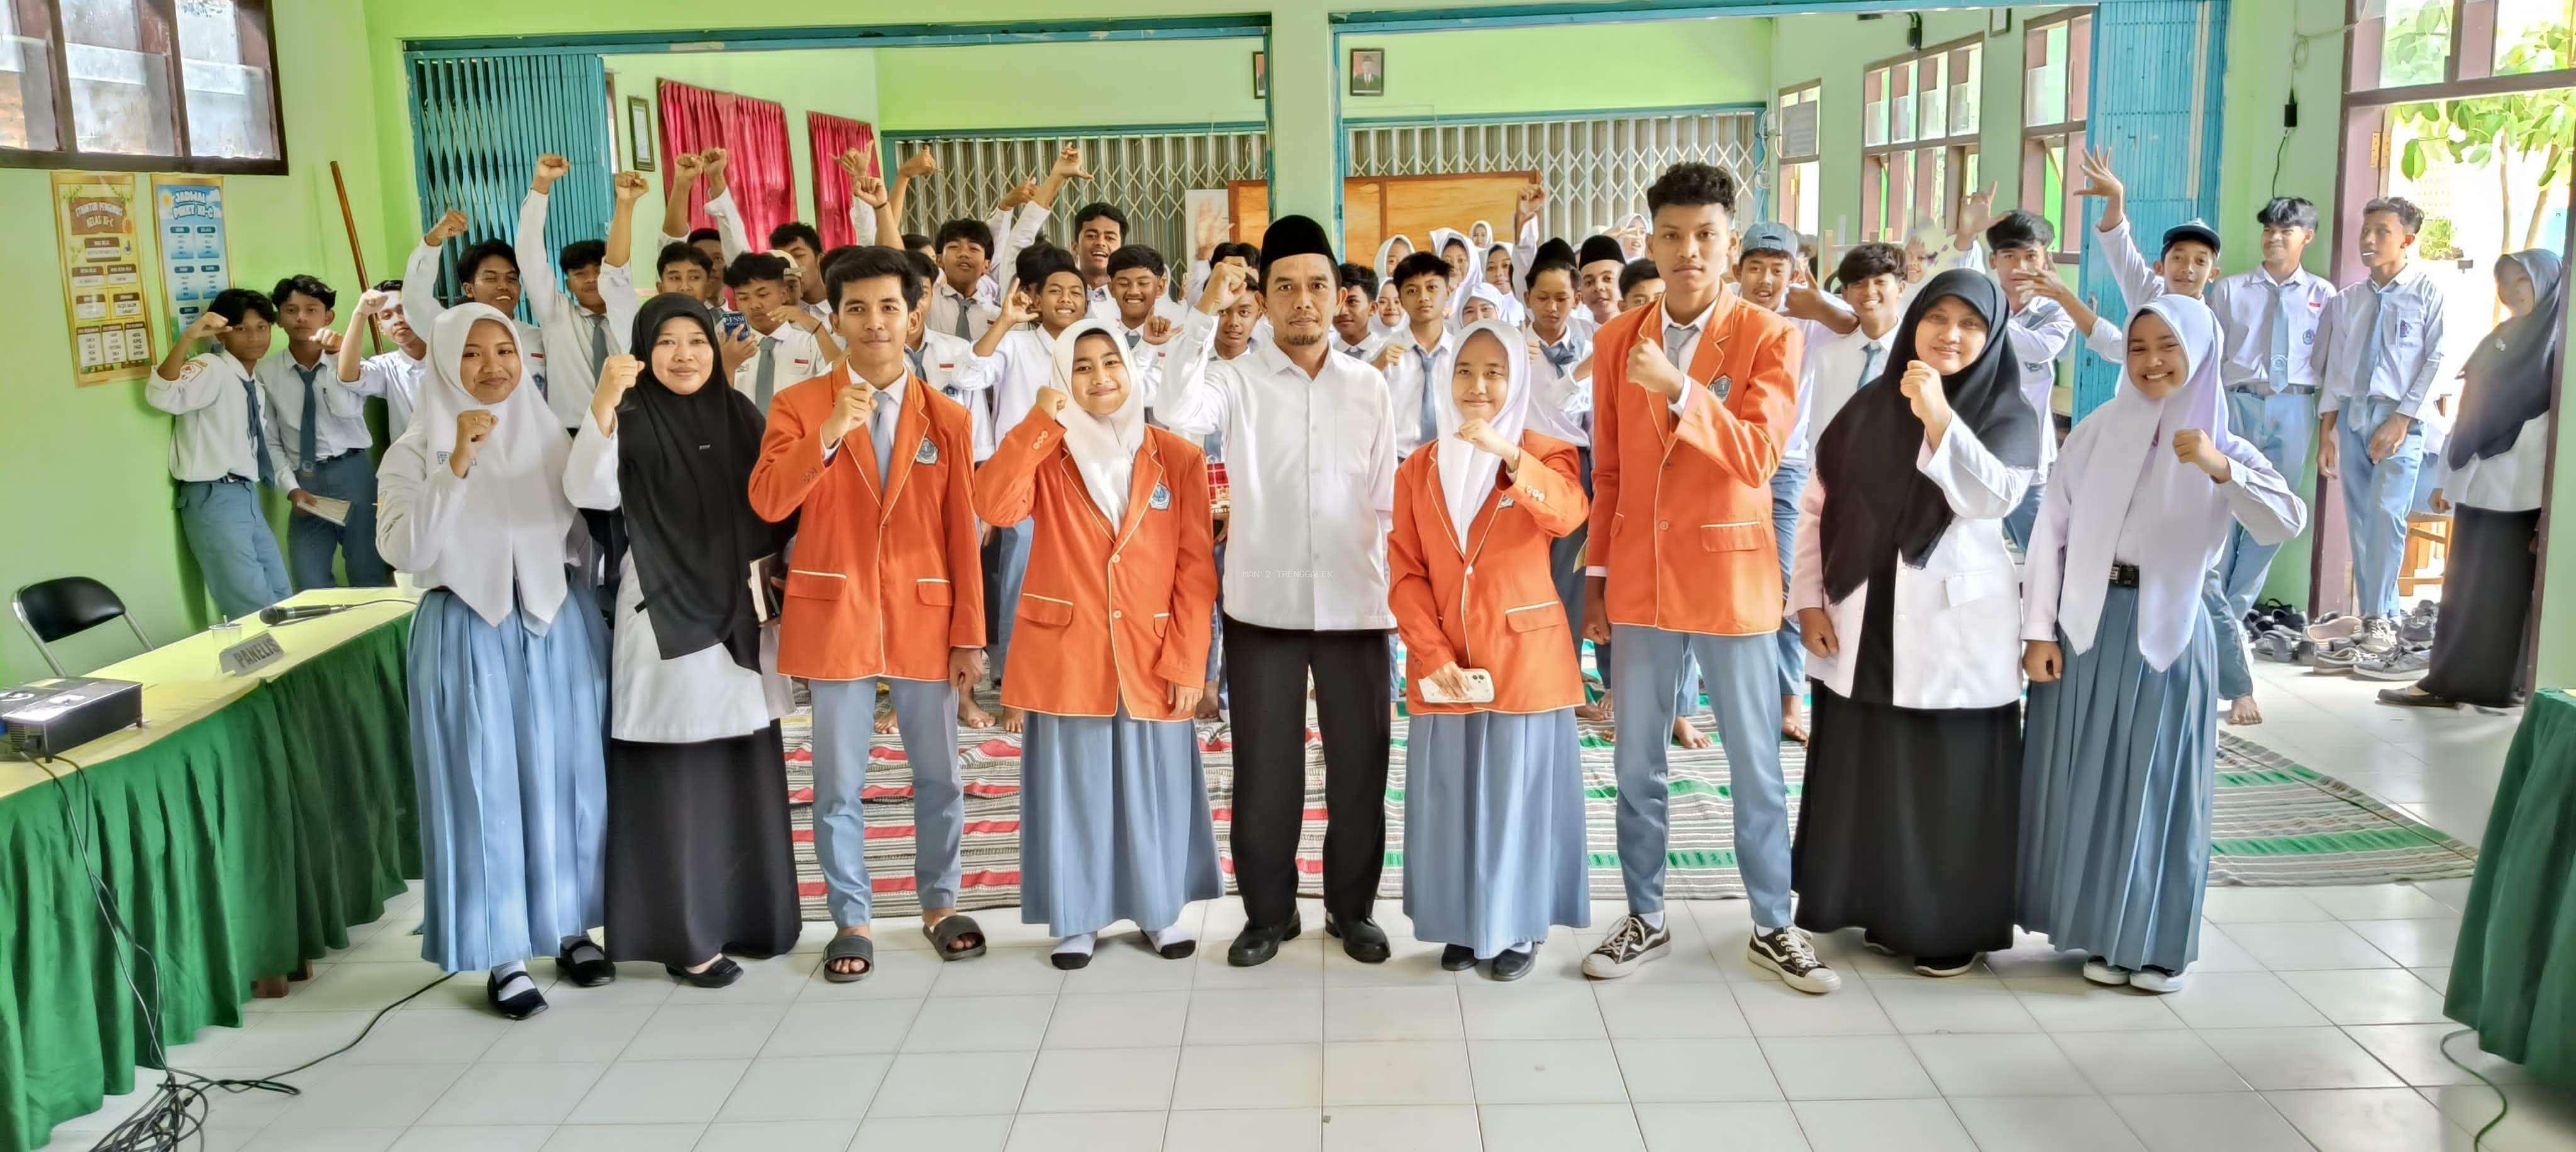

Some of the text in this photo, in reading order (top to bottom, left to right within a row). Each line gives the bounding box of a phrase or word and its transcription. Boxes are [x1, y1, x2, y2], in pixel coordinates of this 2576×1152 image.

[175, 190, 207, 204] JADWAL
[172, 204, 214, 219] PIKET XI-C
[86, 214, 102, 228] KELAS
[233, 637, 281, 668] PANELIS
